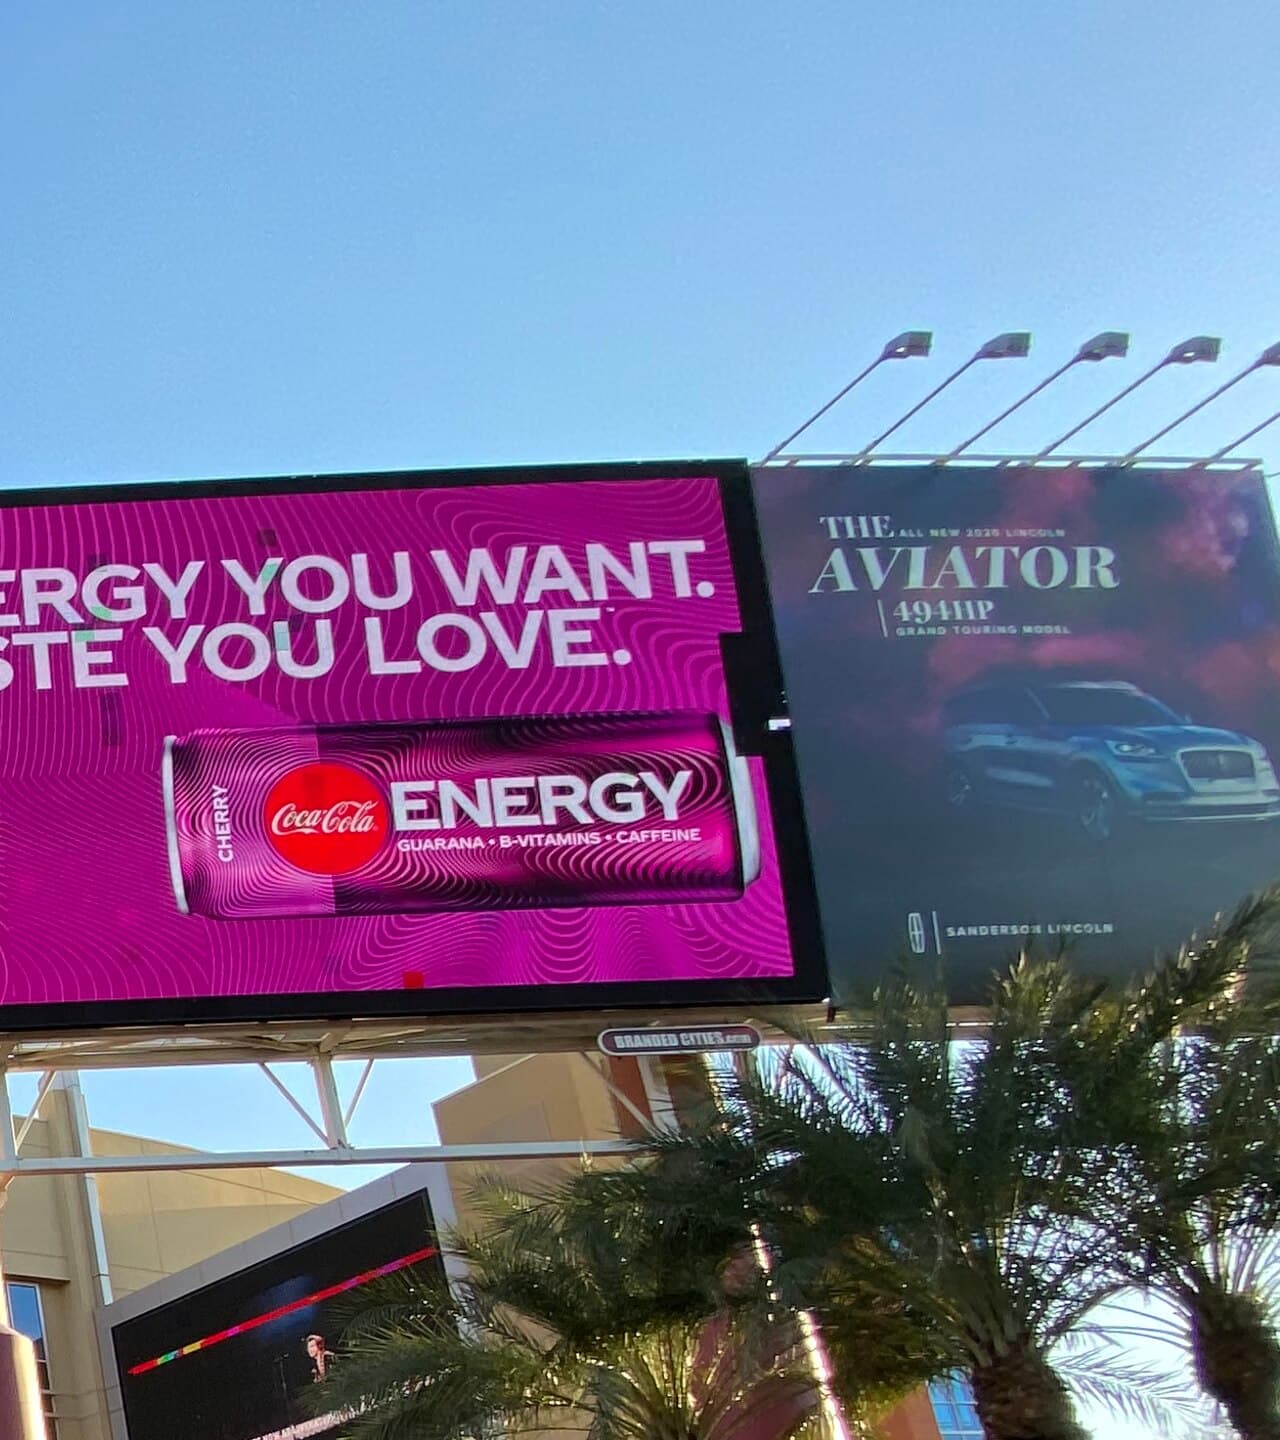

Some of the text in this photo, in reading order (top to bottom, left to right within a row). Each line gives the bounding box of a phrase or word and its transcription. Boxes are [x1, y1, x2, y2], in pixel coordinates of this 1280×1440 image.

[819, 515, 895, 539] THE
[898, 528, 923, 538] ALL
[929, 528, 960, 538] NEW
[1005, 528, 1065, 538] LINCOLN
[221, 552, 413, 619] YOU
[430, 539, 715, 606] WANT.
[808, 545, 1121, 594] AVIATOR
[892, 600, 995, 624] 494HP
[895, 624, 1072, 637] GRAND TOURING MODEL
[147, 619, 333, 686] YOU
[366, 607, 632, 676] LOVE.
[389, 769, 695, 832] ENERGY
[212, 783, 234, 863] CHERRY
[271, 799, 380, 836] Coca-Cola
[397, 827, 702, 853] GUARANA B-VITAMINS CAFFEINE
[945, 923, 1114, 938] SANDERSON LINCOLN
[613, 1033, 680, 1049] BRANDED
